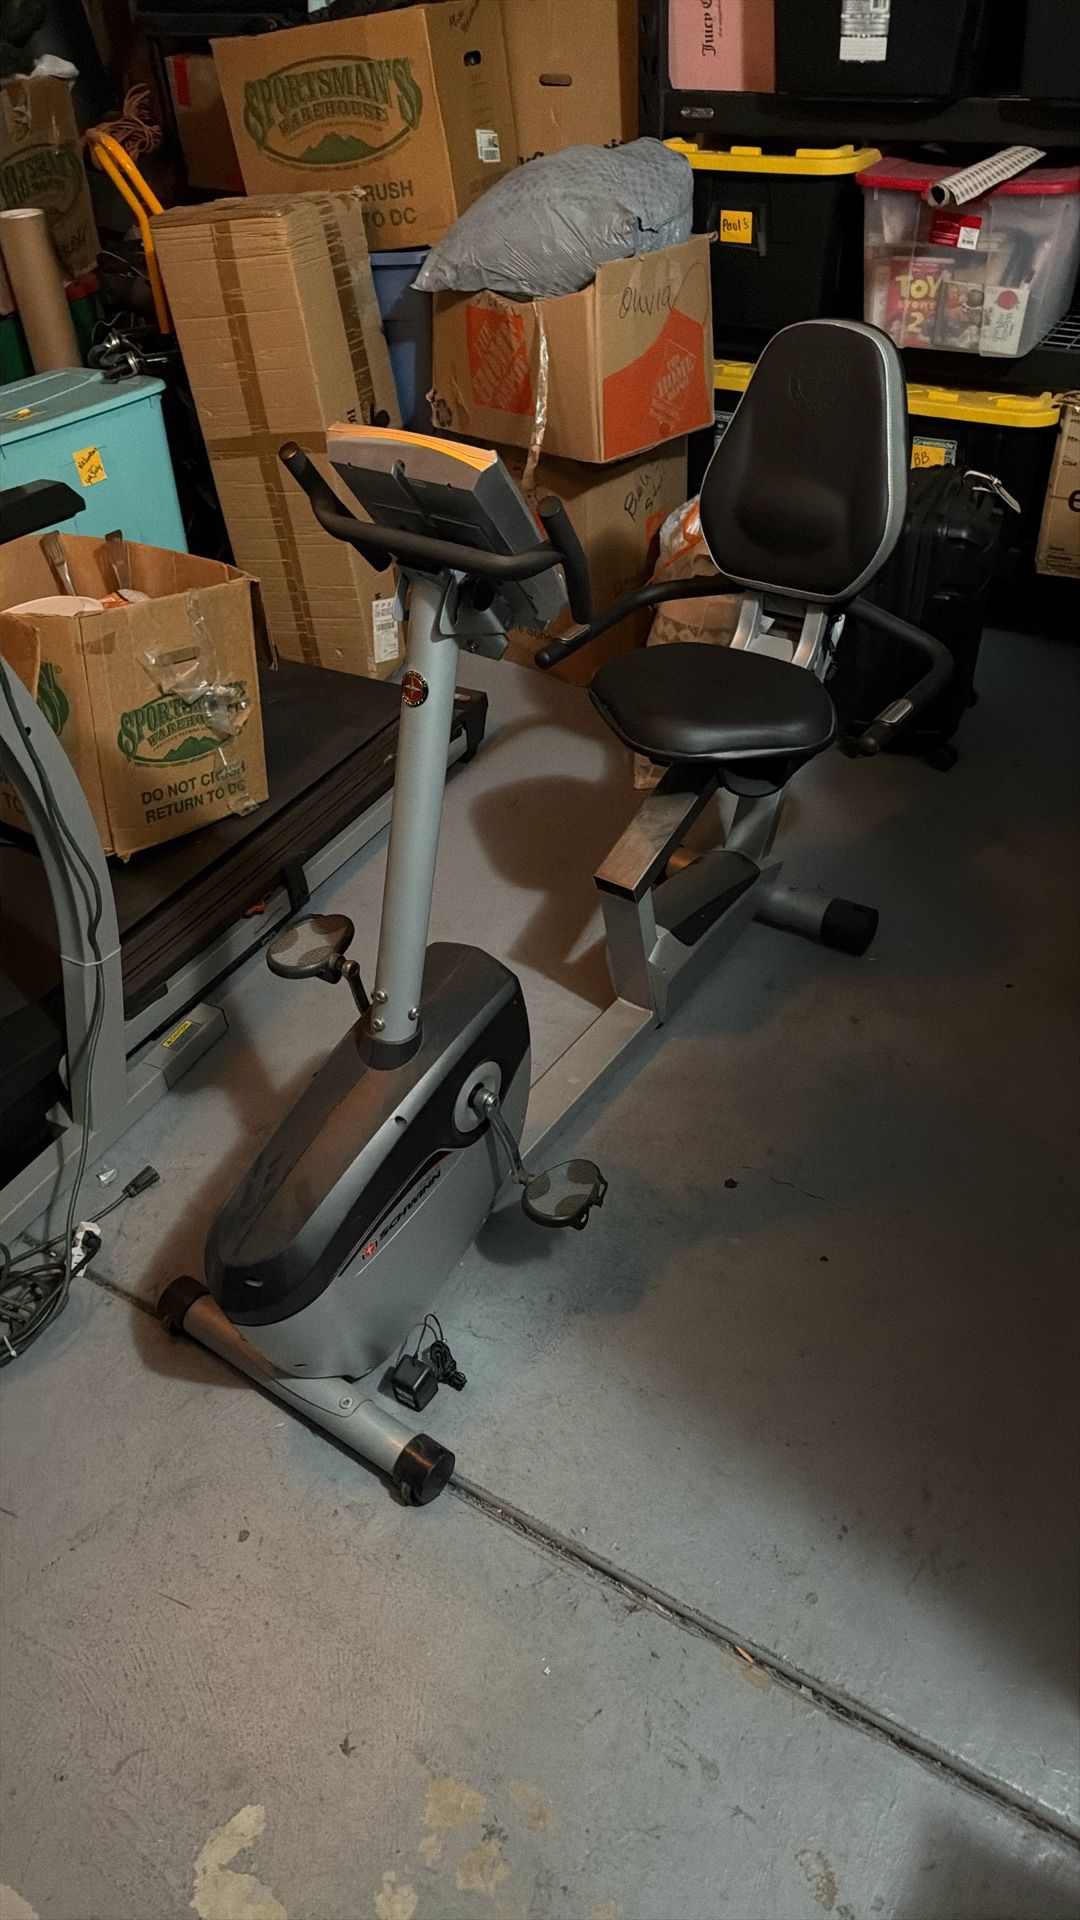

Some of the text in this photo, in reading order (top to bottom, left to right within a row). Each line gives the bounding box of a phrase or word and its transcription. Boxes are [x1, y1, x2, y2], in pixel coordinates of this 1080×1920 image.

[243, 57, 423, 147] SPORTSMAN'S
[278, 100, 390, 136] WAREHOUSE
[389, 207, 417, 225] DC
[895, 274, 940, 300] TOY
[906, 311, 926, 334] 2
[141, 787, 164, 805] DO
[166, 776, 197, 800] NOT
[144, 795, 203, 825] RETURN
[206, 787, 226, 803] TO
[379, 1168, 442, 1241] SCHWINN
